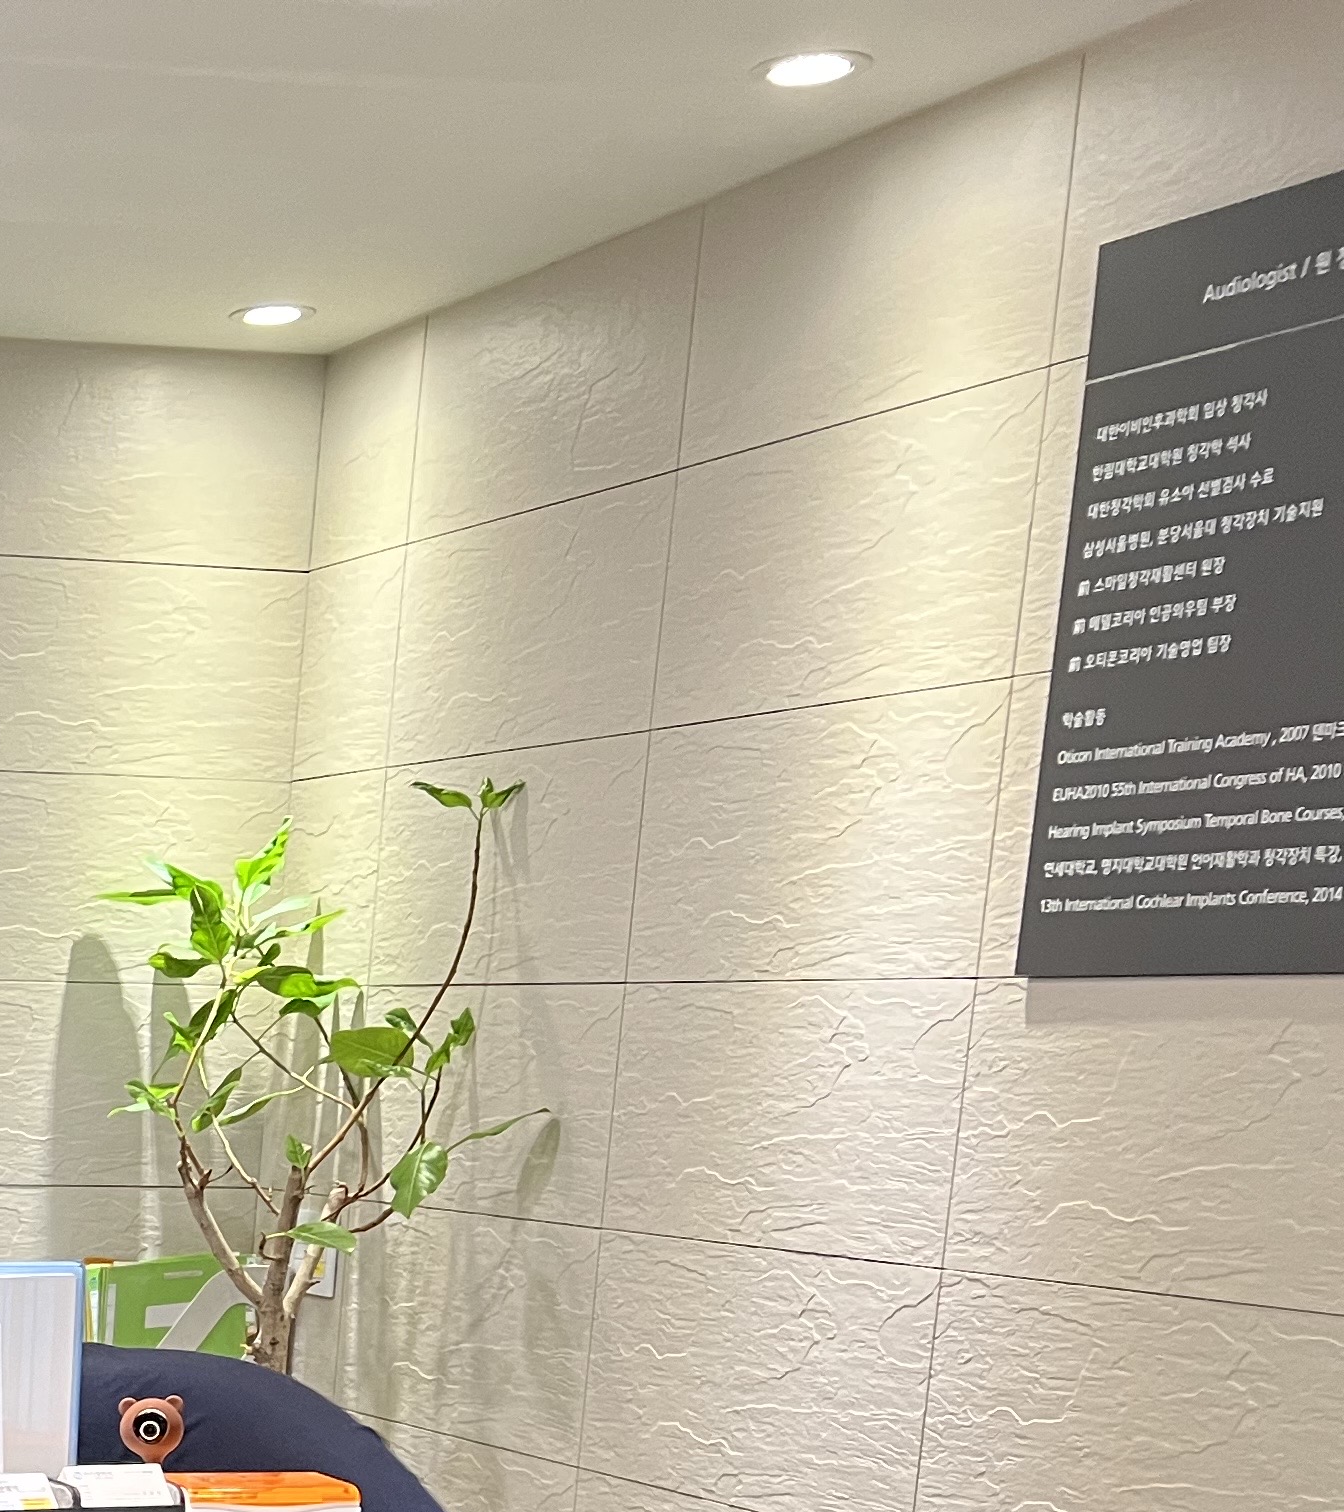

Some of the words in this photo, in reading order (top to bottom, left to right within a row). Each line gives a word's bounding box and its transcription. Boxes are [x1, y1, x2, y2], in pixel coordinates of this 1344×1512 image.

[1203, 262, 1297, 304] Audiologist
[1096, 404, 1200, 442] 대한이비인후과학회
[1092, 447, 1184, 482] 한림대학교대학원
[1226, 431, 1252, 453] 석사
[1158, 483, 1194, 506] 유소아
[1250, 467, 1274, 487] 수료
[1272, 498, 1324, 522] 기술지원
[1093, 560, 1197, 592] 스마일청각재활센터
[1201, 556, 1225, 576] 원장
[1149, 598, 1209, 623] 인공와우팀
[1210, 594, 1237, 613] 부장
[1083, 645, 1152, 669] 오티콘코리아
[1156, 637, 1203, 659] 기술영업
[1207, 634, 1231, 653] 팀장
[1094, 740, 1165, 761] International
[1167, 735, 1213, 754] Training
[1215, 731, 1271, 749] Academy
[1279, 724, 1310, 743] 2007
[1052, 784, 1109, 801] EUHA2010
[1110, 781, 1137, 797] 55th
[1138, 774, 1212, 795] International
[1213, 772, 1267, 789] Congress
[1269, 767, 1284, 783] of
[1311, 763, 1342, 780] 2010
[1048, 823, 1091, 840] Hearing
[1092, 820, 1134, 838] Implant
[1135, 814, 1201, 836] Symposium
[1204, 810, 1259, 830] Temporal
[1261, 809, 1292, 824] Bone
[1101, 853, 1189, 876] 명지대학교대학원
[1040, 898, 1062, 913] 13th
[1064, 895, 1134, 912] International
[1136, 893, 1184, 909] Cochlear
[1185, 891, 1237, 909] Implants
[1239, 888, 1309, 905] Conference,
[1312, 886, 1343, 902] 2014
